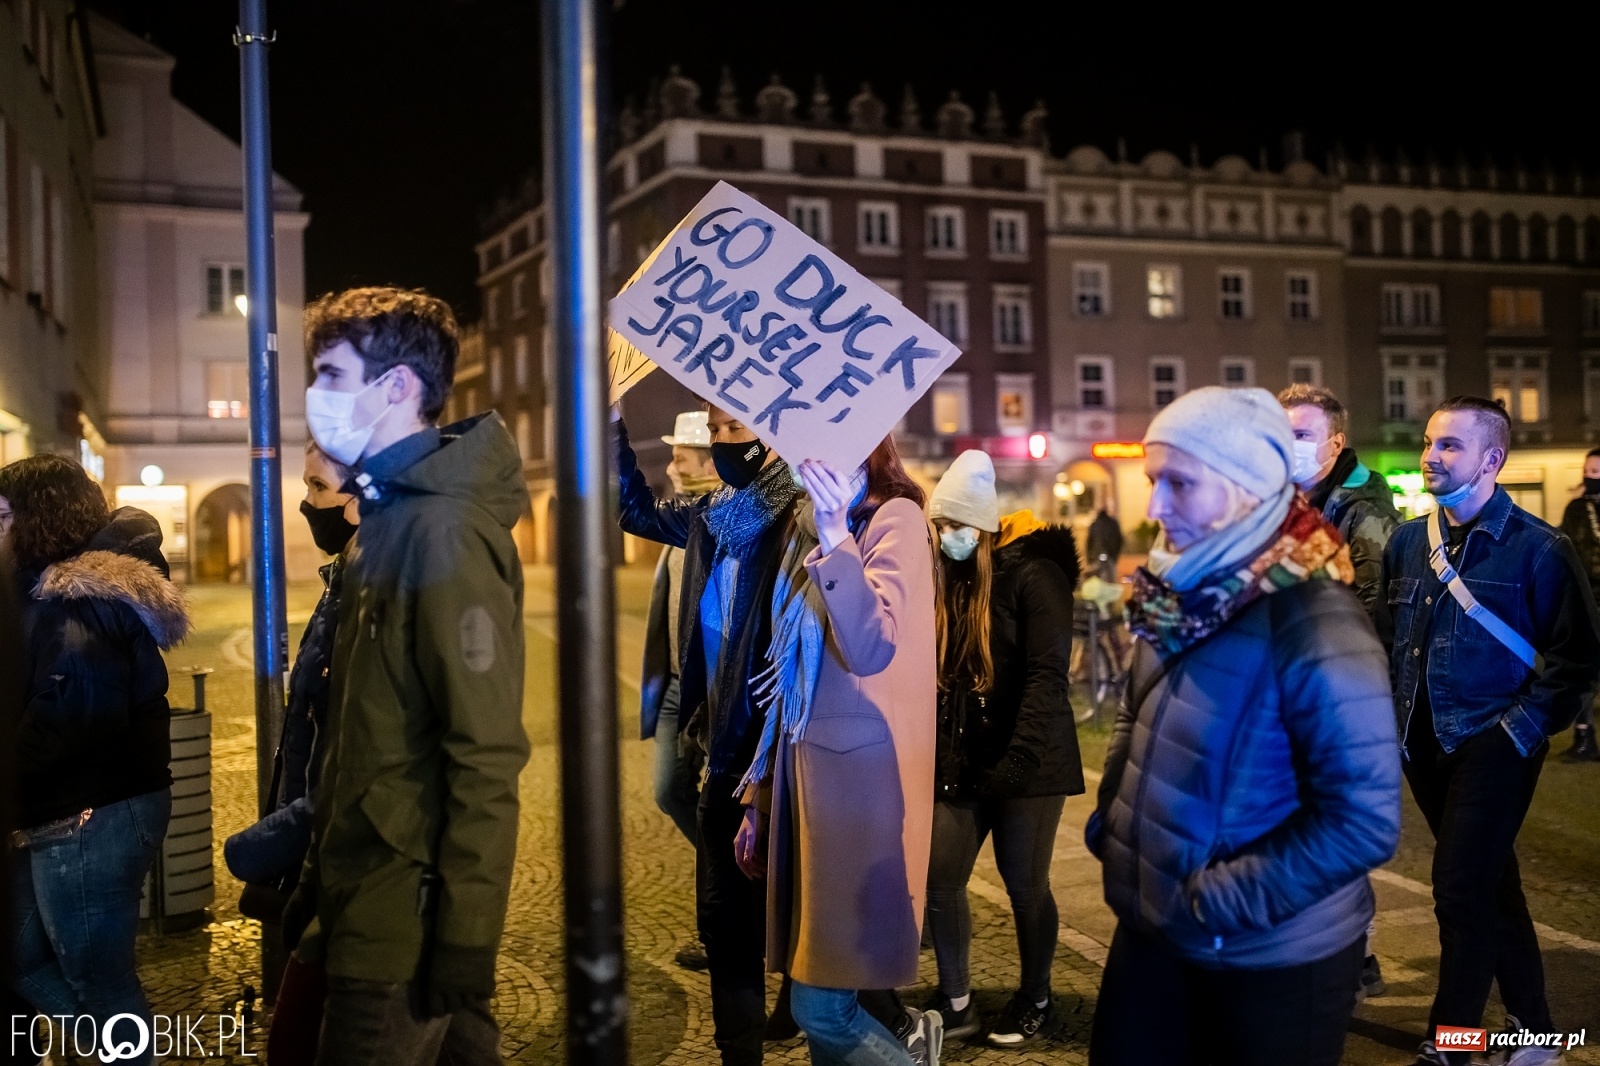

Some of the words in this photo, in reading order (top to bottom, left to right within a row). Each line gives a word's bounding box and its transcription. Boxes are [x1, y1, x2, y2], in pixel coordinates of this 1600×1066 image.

[627, 295, 812, 436] JAREK
[689, 206, 776, 269] GO
[774, 253, 941, 391] DUCK
